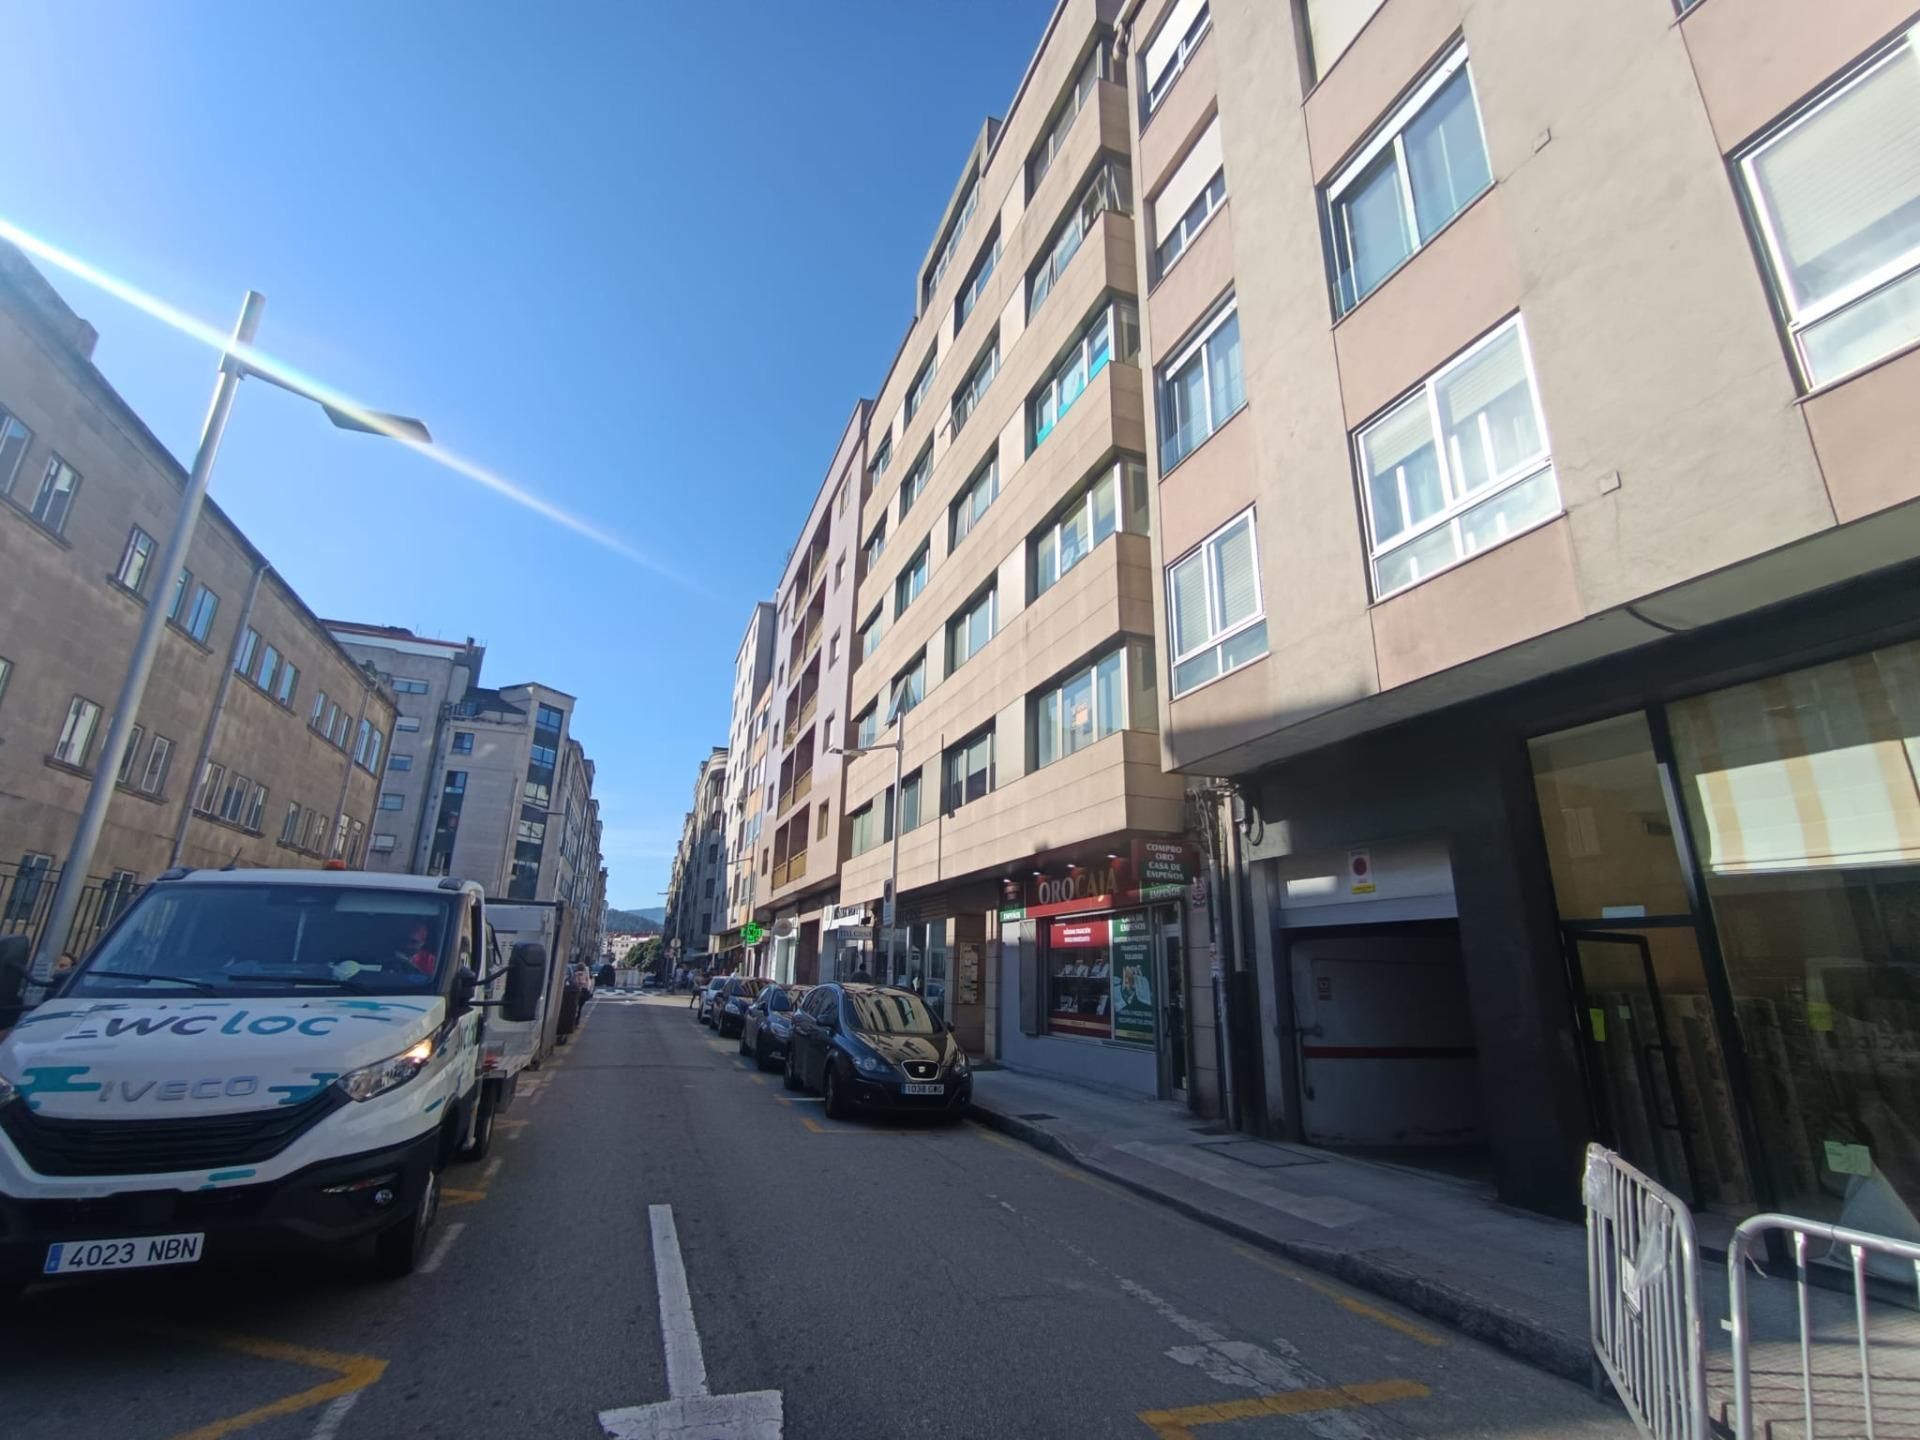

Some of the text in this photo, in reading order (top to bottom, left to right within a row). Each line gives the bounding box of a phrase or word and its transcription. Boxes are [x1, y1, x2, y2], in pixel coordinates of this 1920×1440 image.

[1146, 843, 1182, 854] COMPRO
[1155, 852, 1174, 861] ORO
[1148, 861, 1181, 872] CASA DE
[1146, 870, 1184, 881] EMPEÑOS
[98, 1076, 259, 1103] IVECO
[69, 1236, 200, 1269] 4023 NBN
